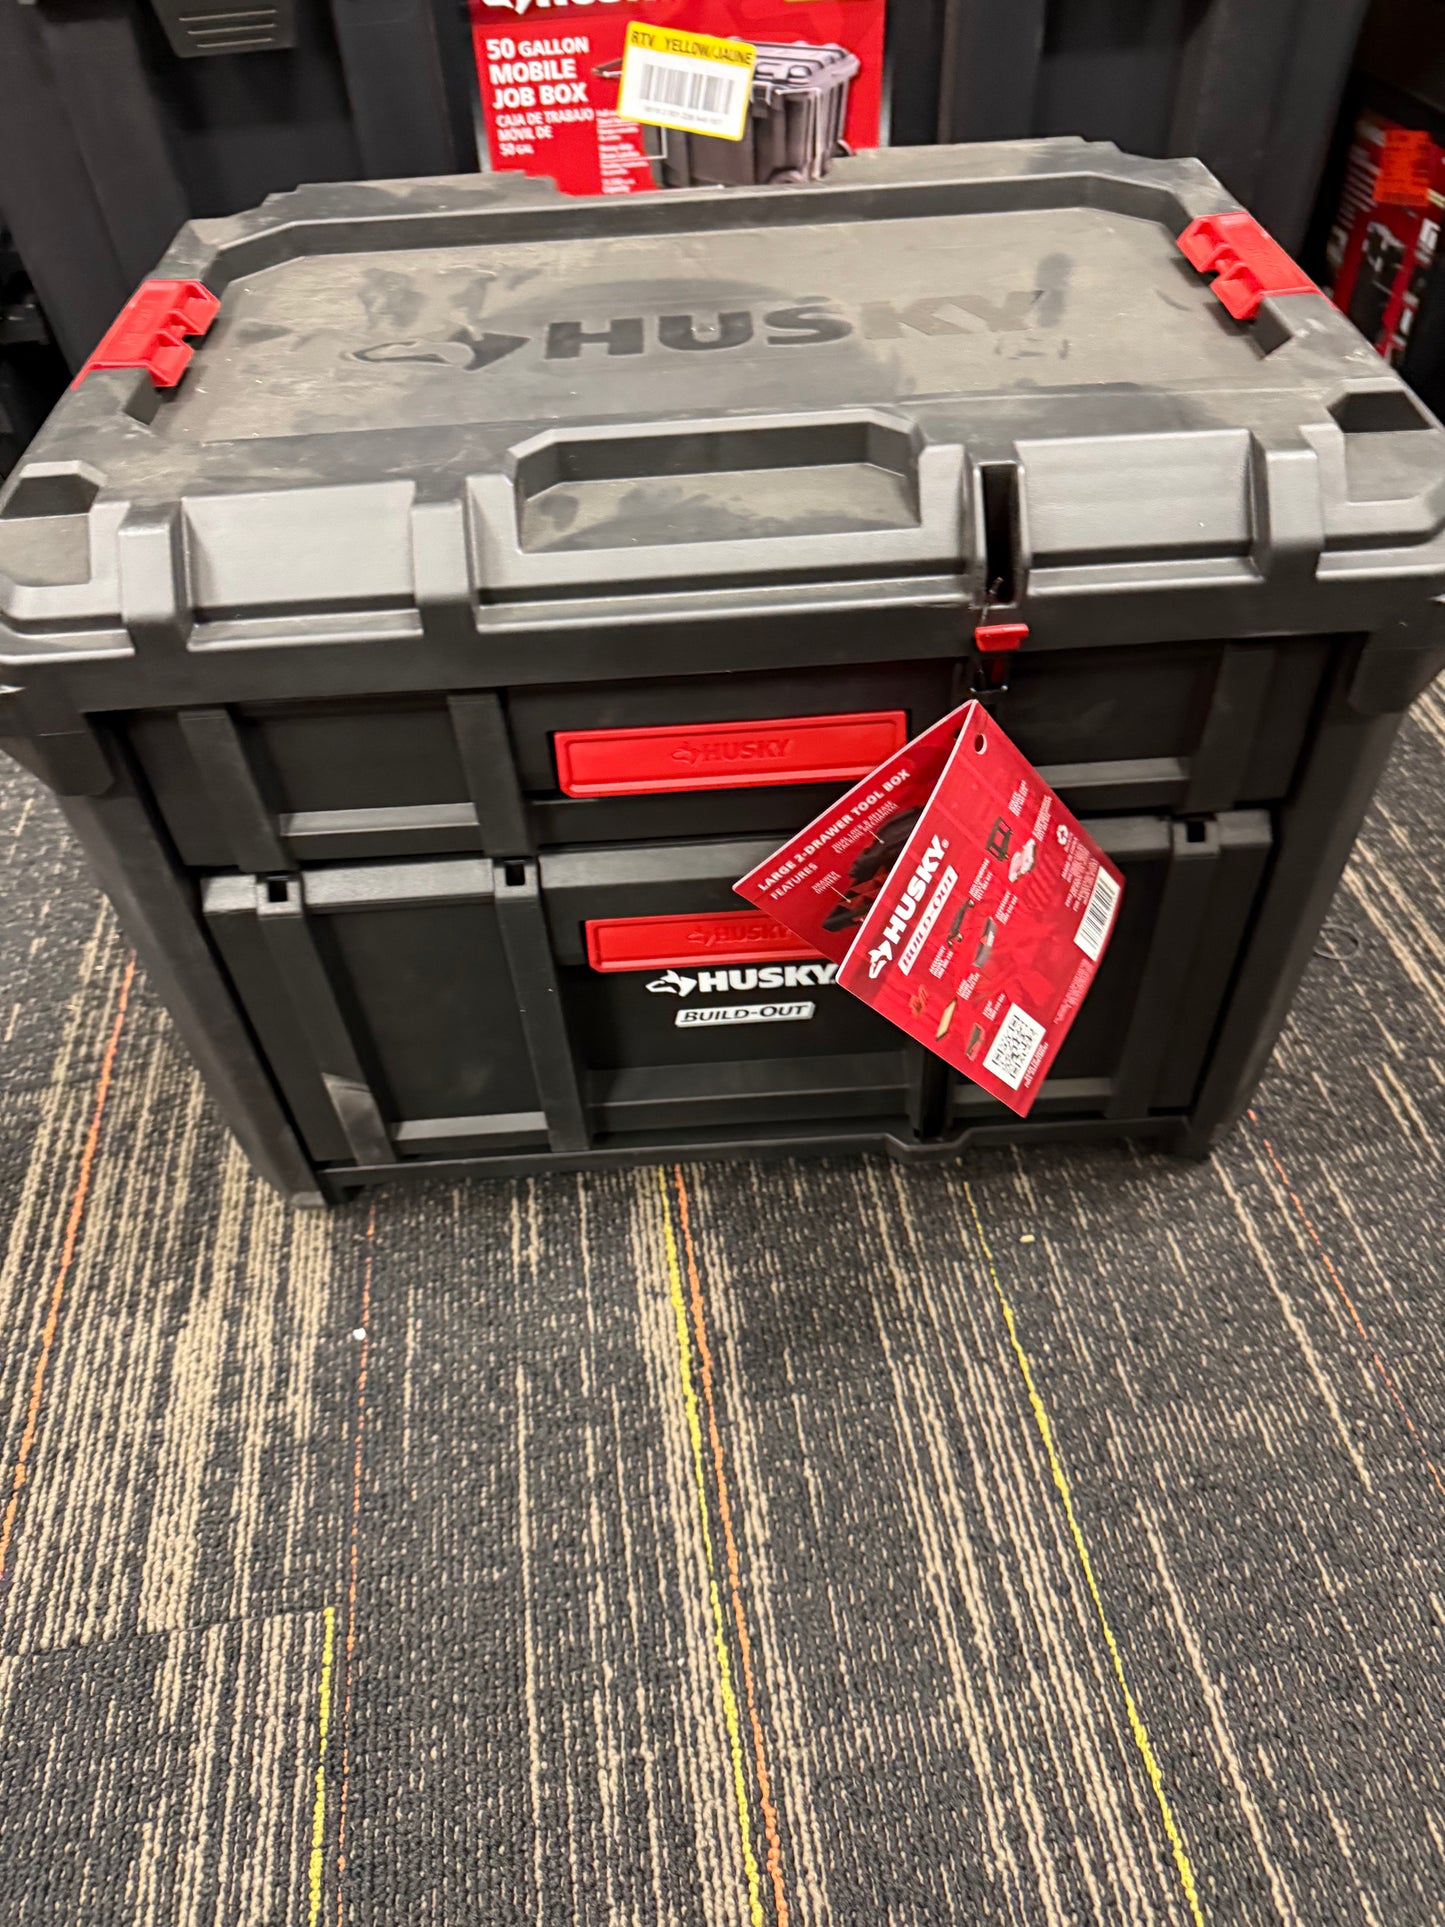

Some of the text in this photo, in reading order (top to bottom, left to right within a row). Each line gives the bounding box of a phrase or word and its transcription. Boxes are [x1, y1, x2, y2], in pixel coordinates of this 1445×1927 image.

[485, 36, 590, 60] 50 GALLON
[631, 30, 655, 48] RTV
[488, 58, 577, 85] MOBILE
[492, 82, 589, 110] JOB BOX
[495, 113, 526, 128] CAJA
[526, 111, 545, 126] DE
[544, 107, 596, 125] TRABAJO
[535, 125, 554, 140] DE
[498, 142, 516, 157] 50
[543, 289, 1045, 361] HUSKY
[702, 738, 791, 763] HUSKY
[757, 767, 911, 893] LARGE 2-DRAWER TOOL BOX
[769, 860, 819, 902] FEATURES
[882, 834, 949, 946] HUSKY
[901, 870, 953, 970] BUILD-OUT
[697, 964, 838, 992] HUSKY
[679, 1004, 808, 1023] BUILD-OUT
